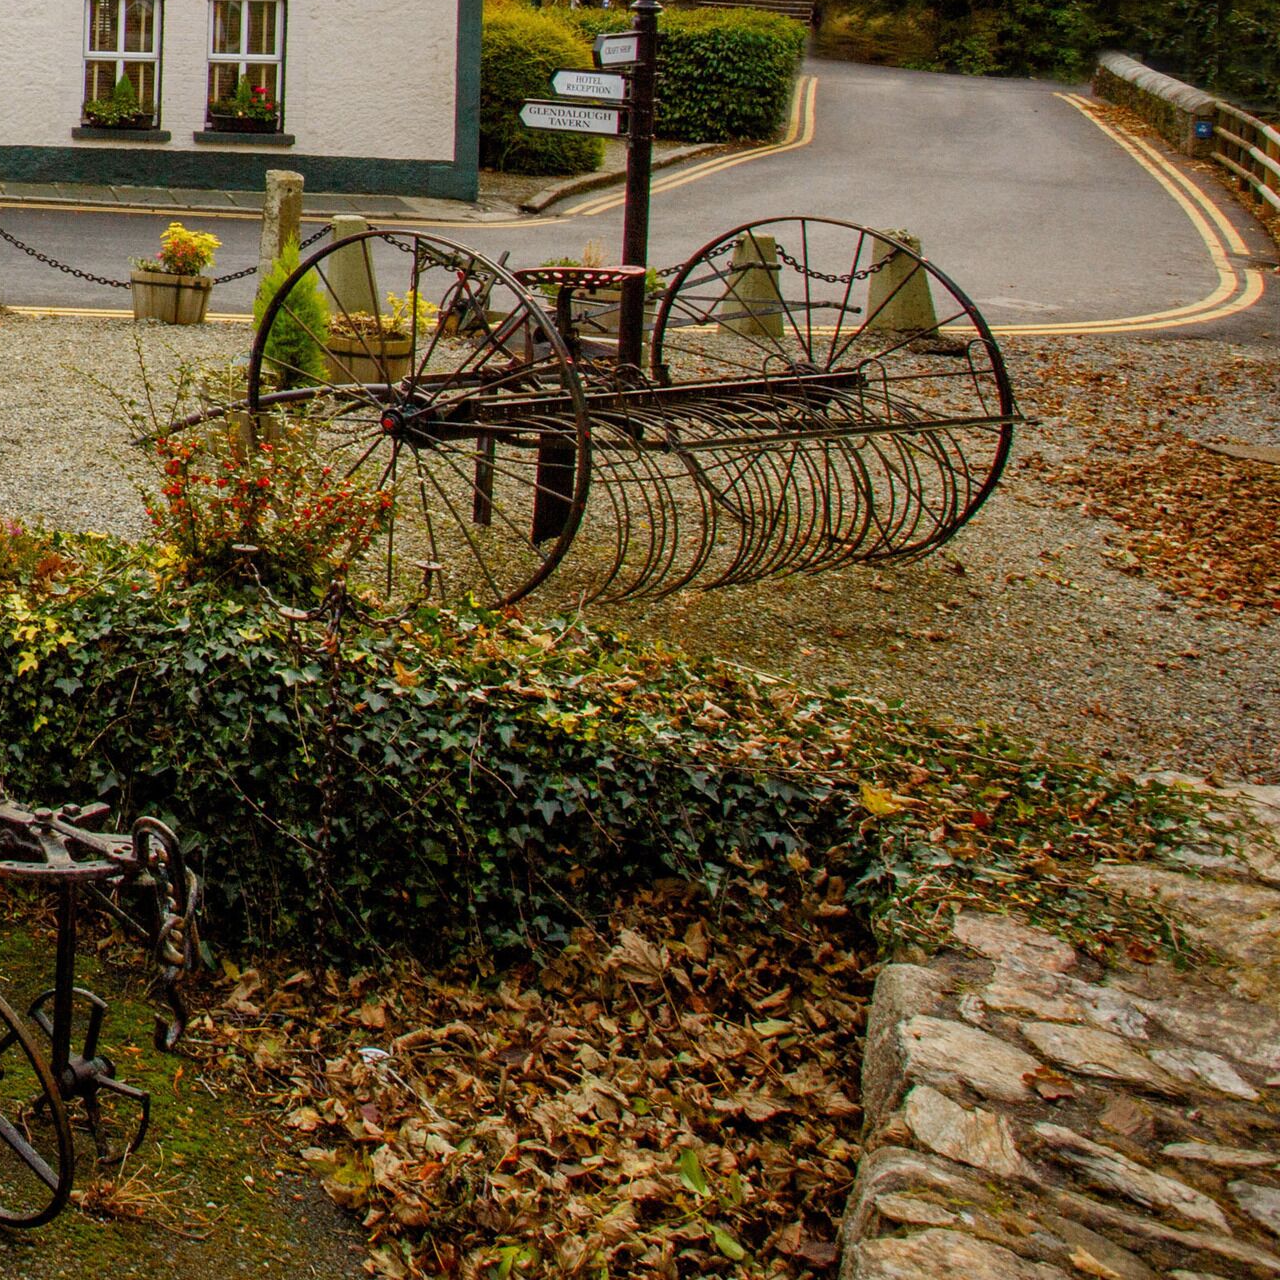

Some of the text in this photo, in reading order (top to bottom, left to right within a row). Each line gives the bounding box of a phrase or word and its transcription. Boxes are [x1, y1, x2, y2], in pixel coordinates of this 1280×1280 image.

[576, 75, 602, 85] HOTEL
[566, 84, 611, 95] RECEPTION
[529, 106, 612, 121] GLENDALOUGH
[548, 117, 591, 128] TAVERN
